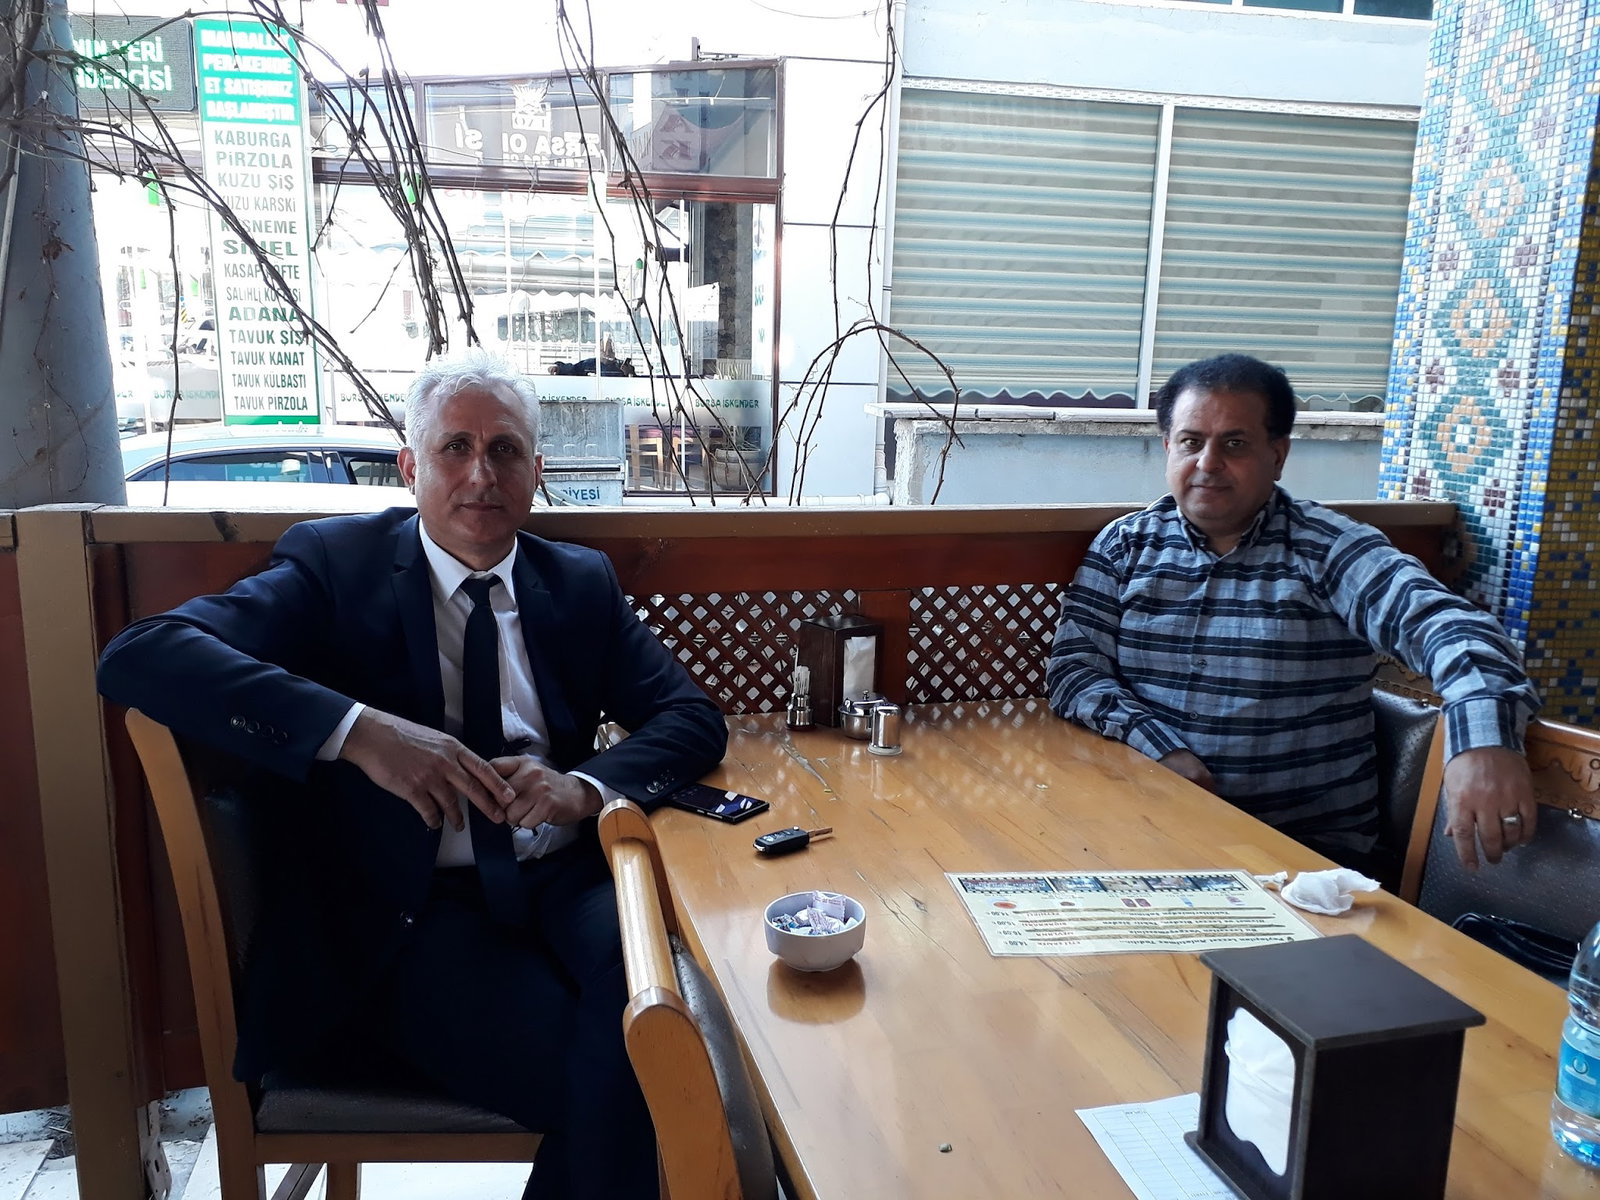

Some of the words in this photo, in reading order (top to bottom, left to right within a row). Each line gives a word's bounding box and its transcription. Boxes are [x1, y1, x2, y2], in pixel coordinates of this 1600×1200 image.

[204, 77, 221, 94] ET
[214, 130, 291, 148] KABURGA
[218, 172, 260, 188] KUZU
[222, 195, 249, 211] UZU
[221, 219, 297, 235] KNEME
[224, 263, 260, 278] KASAP
[265, 261, 300, 279] FTE
[229, 306, 301, 322] ADANA
[229, 329, 275, 344] TAVUK
[231, 351, 266, 365] TAVUK
[269, 351, 304, 366] KANAT
[232, 373, 261, 388] TAVUK
[264, 370, 306, 388] KÜLBASTI
[234, 396, 265, 410] TAVUK
[268, 393, 308, 411] PİRZOLA
